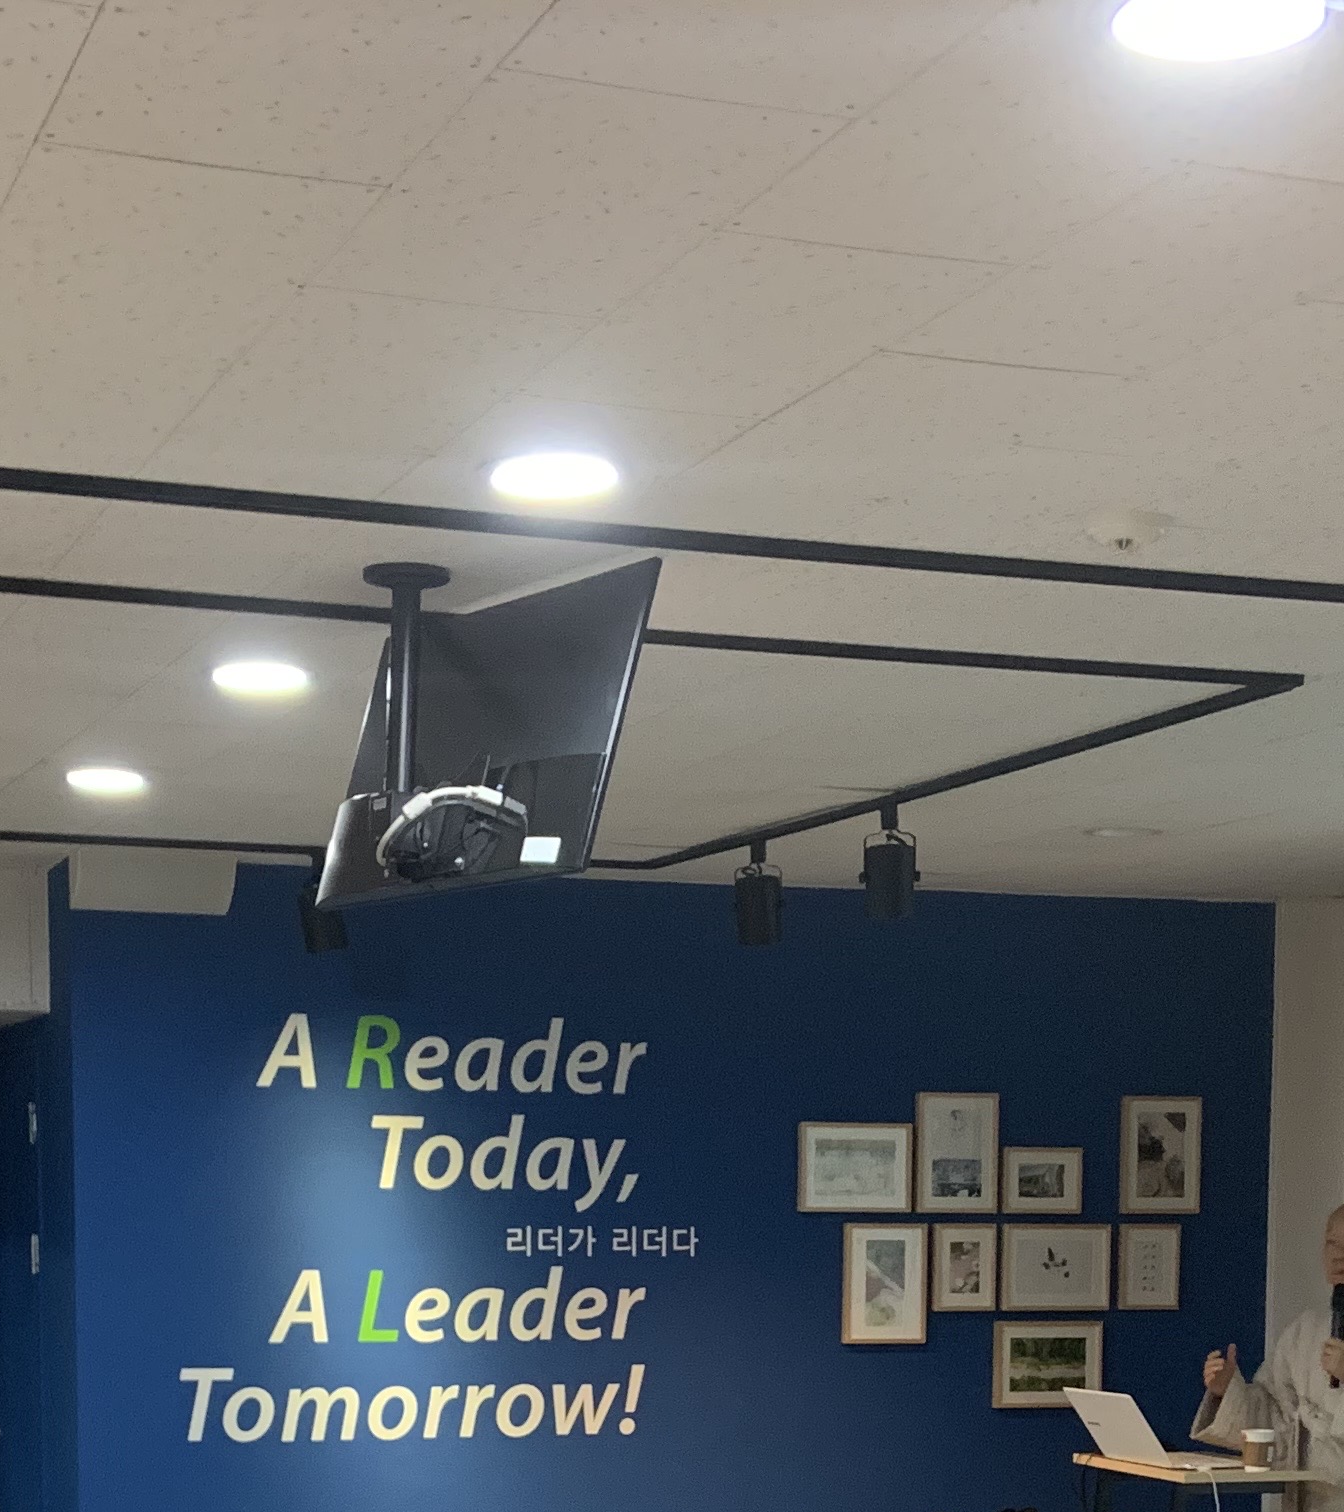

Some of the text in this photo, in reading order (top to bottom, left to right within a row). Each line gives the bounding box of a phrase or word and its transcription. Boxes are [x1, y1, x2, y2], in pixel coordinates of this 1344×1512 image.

[256, 1013, 647, 1095] A Reader
[370, 1114, 639, 1212] Today,
[505, 1225, 700, 1257] 리더가 리더다
[268, 1266, 646, 1344] A Leader
[179, 1364, 645, 1443] Tomorrow!
